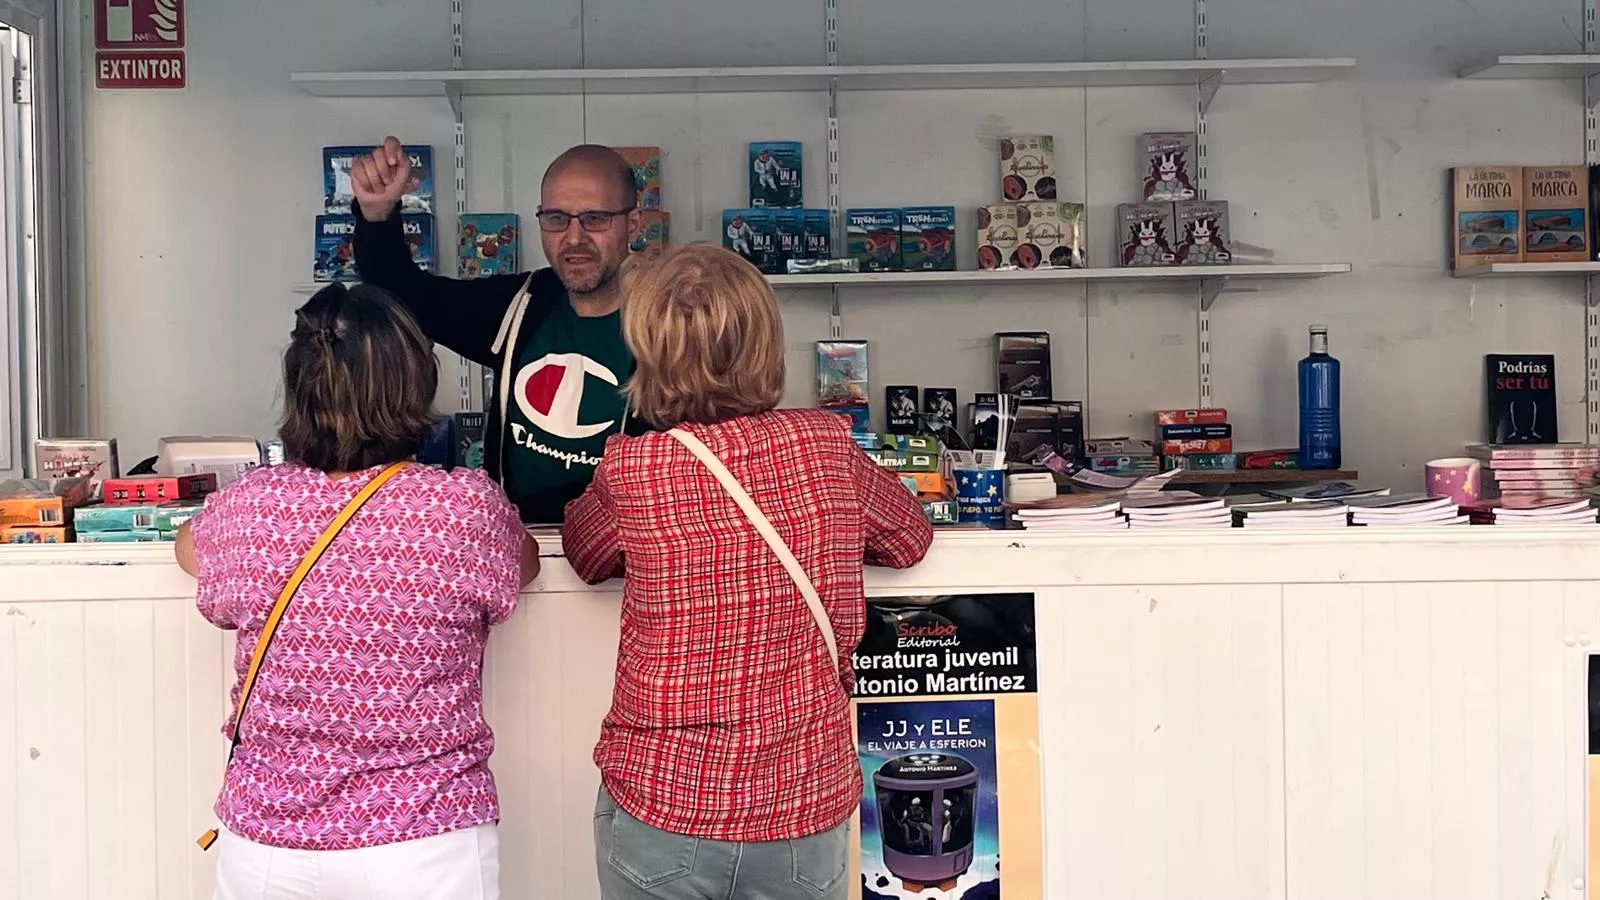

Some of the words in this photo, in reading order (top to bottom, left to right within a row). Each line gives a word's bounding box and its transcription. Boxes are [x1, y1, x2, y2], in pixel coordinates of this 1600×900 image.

[100, 59, 182, 80] EXTINTOR
[1466, 182, 1512, 198] MARCA
[1531, 180, 1578, 197] MARCA
[1498, 360, 1548, 374] Podrías
[1496, 376, 1523, 390] ser
[1530, 374, 1549, 390] tú
[461, 416, 482, 428] THIEF
[511, 422, 604, 470] Champio
[897, 621, 958, 636] Scribo
[897, 635, 961, 649] Editorial
[850, 650, 938, 670] teratura
[943, 646, 1019, 672] juvenil
[853, 677, 918, 695] tonio
[926, 671, 1026, 693] Martínez
[882, 719, 908, 737] JJ
[931, 718, 972, 736] ELE
[868, 741, 882, 751] EL
[884, 740, 916, 750] VIAJE
[918, 740, 927, 750] A
[930, 738, 987, 749] ESFERION
